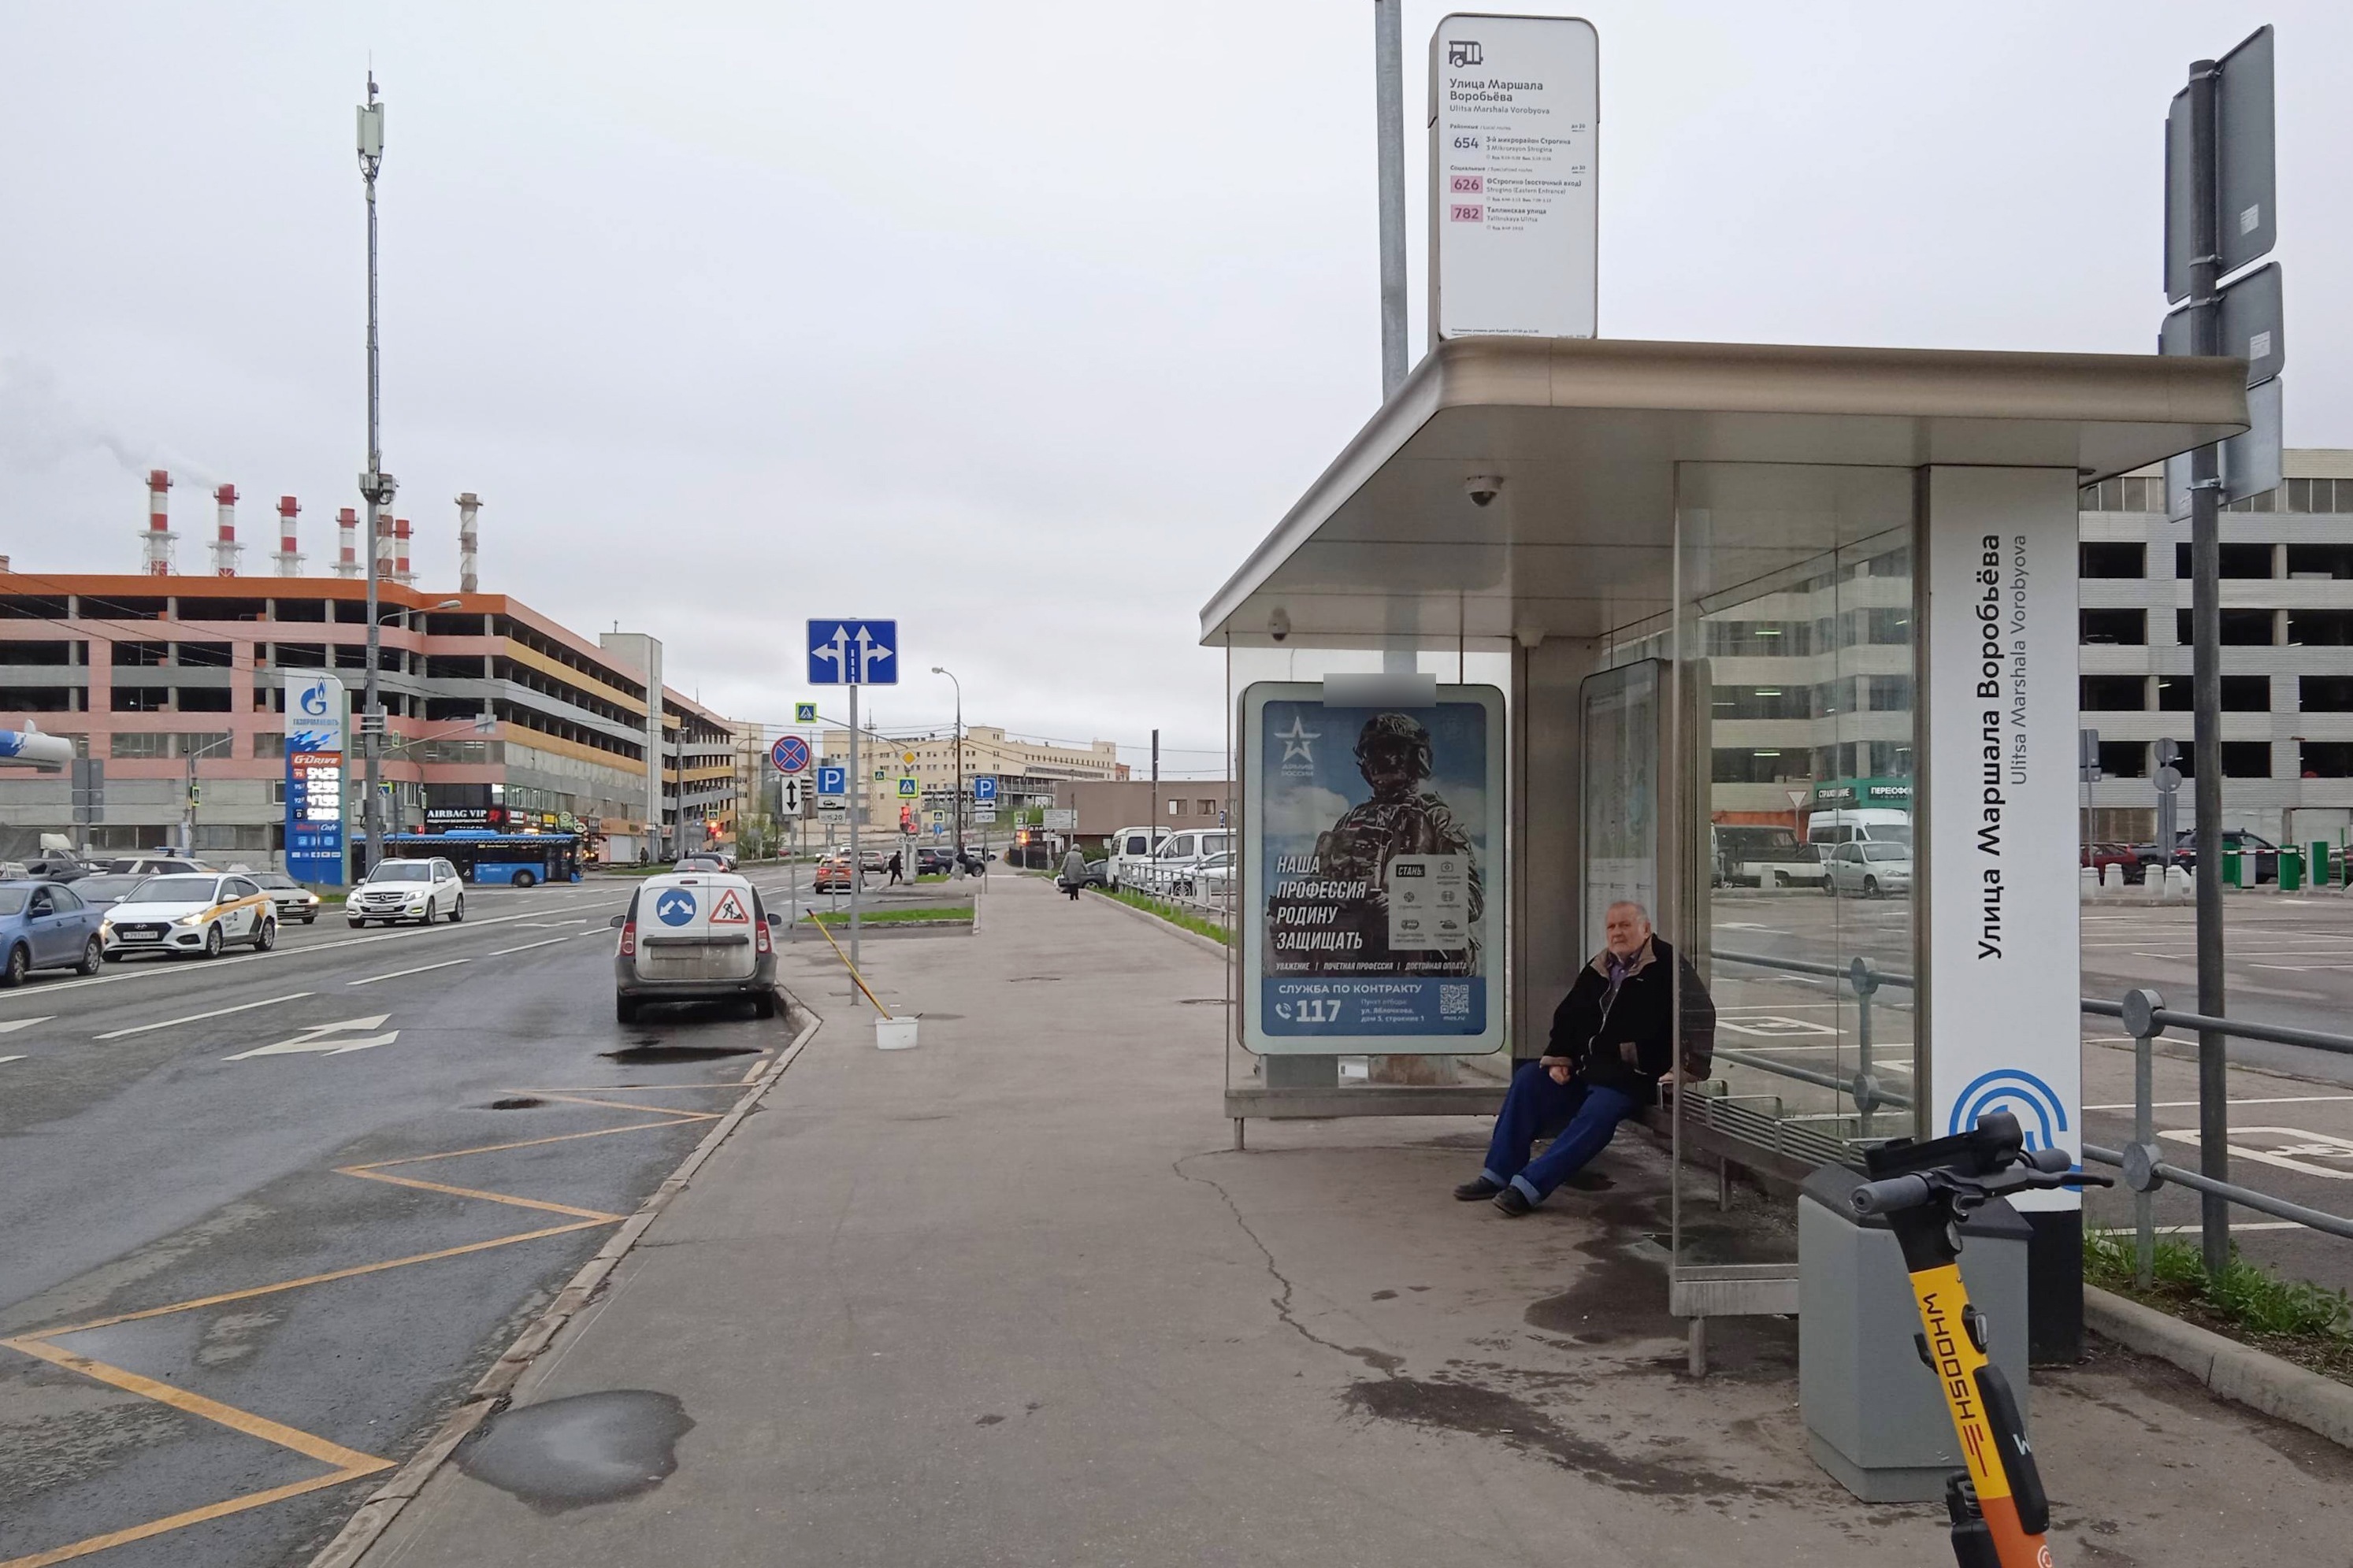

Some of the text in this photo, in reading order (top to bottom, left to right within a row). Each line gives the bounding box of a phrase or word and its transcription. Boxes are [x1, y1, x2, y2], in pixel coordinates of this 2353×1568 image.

[1449, 78, 1543, 91] Улица Маршала
[1450, 91, 1512, 103] Воробьёва
[1474, 105, 1509, 113] Marshala
[1510, 106, 1549, 115] Vorobyova
[1454, 136, 1479, 149] 654
[1454, 178, 1479, 191] 626
[1454, 208, 1479, 219] 782
[2010, 536, 2029, 784] Ulitsa Marshala Vorobyova
[1976, 535, 2006, 960] Улица Маршала Воробьёва
[825, 770, 840, 791] P
[980, 780, 992, 797] P
[1818, 788, 1850, 799] СТРАХОАНИЕ
[469, 809, 487, 817] VIP
[1276, 856, 1320, 873] НАША
[1276, 881, 1368, 899] ПРОФЕССИЯ
[1276, 906, 1338, 926] РОДИНУ
[1276, 932, 1363, 951] ЗАЩИЩАТЬ
[1323, 962, 1355, 970] ПОЧЕТНАЯ
[1356, 962, 1394, 970] ПРОФЕССИЯ
[1405, 962, 1442, 970] ДОСТОЙНАЯ
[1279, 984, 1422, 994] СЛУЖБА ПО КОНТРАКТУ
[1296, 999, 1341, 1022] 117
[1923, 1292, 1976, 1421] WHOOSH
